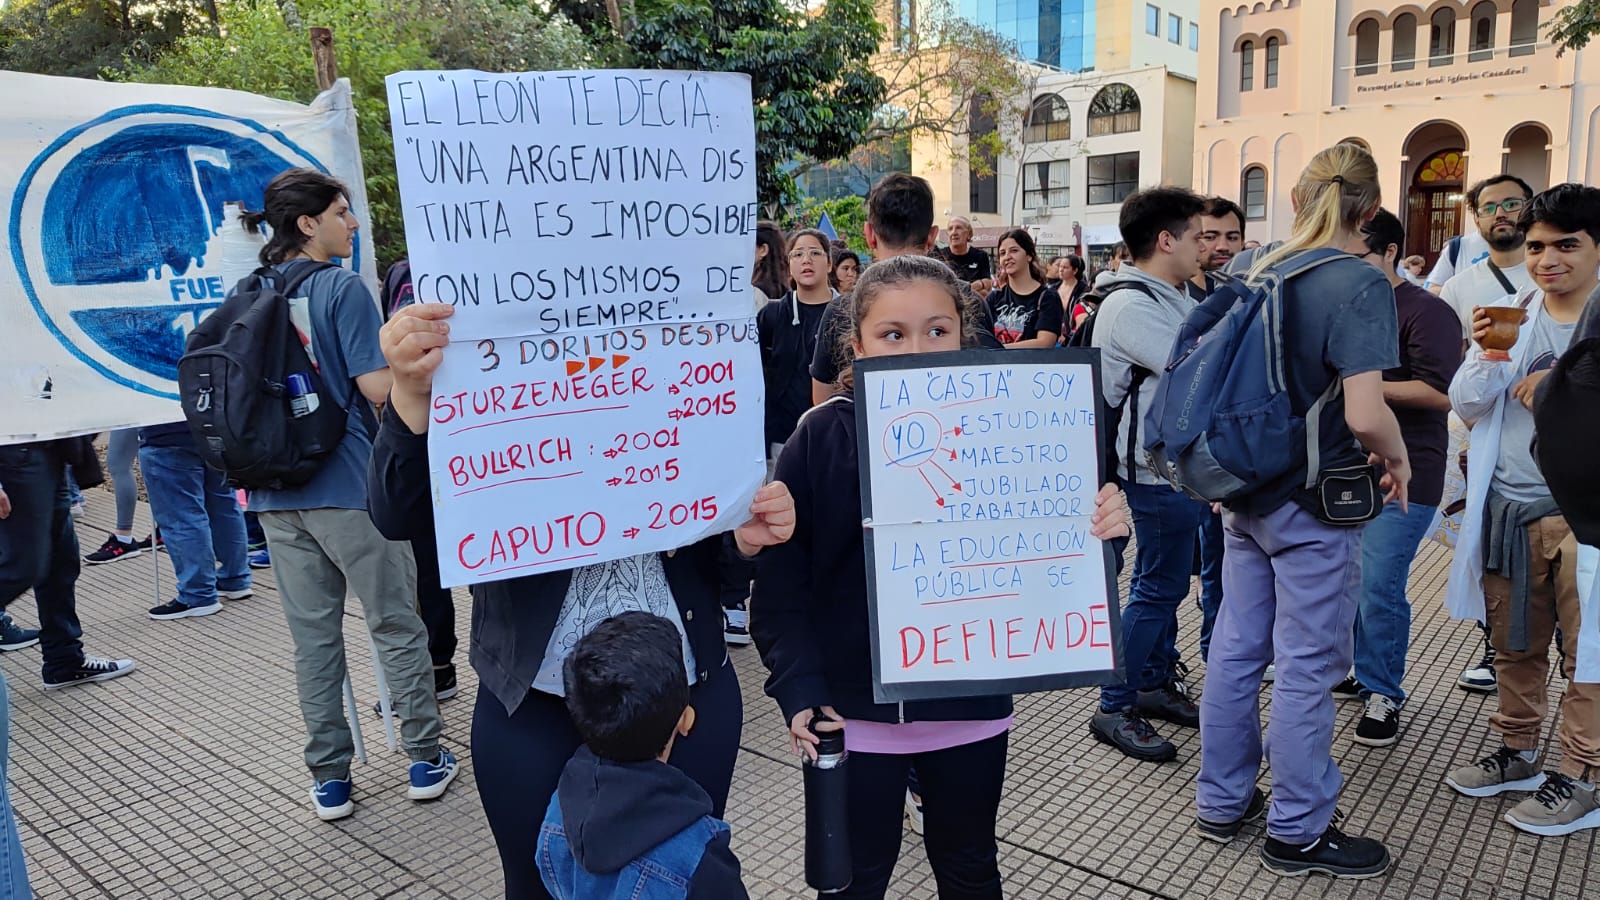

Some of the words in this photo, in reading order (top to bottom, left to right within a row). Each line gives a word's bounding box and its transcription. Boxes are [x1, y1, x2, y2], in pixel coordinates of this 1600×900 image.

[399, 81, 441, 125] EL
[556, 76, 603, 126] TE
[507, 144, 688, 185] ARGENTINA
[416, 200, 511, 243] TINTA
[534, 201, 574, 238] ES
[591, 200, 757, 240] IMPOSIBLE
[417, 272, 480, 306] CON
[493, 268, 556, 304] LOS
[563, 265, 681, 298] MISMOS
[705, 265, 745, 293] DE
[477, 338, 500, 372] 3
[520, 328, 647, 364] DORITOS
[433, 366, 655, 424] STURZENEGER
[680, 360, 734, 388] 2001
[682, 390, 737, 419] 2015
[879, 378, 911, 410] LA
[1032, 371, 1075, 401] SOY
[1181, 359, 1208, 418] CONCEPT
[891, 421, 925, 455] YO
[961, 408, 1095, 436] ESTUDIANTE
[448, 436, 573, 487] BULLRICH
[613, 426, 680, 454] 2001
[624, 457, 680, 486] 2015
[961, 444, 1068, 468] MAESTRO
[964, 473, 1082, 498] JUBILADO
[943, 497, 1082, 521] TRABAJADOR
[457, 511, 606, 570] CAPUTO
[647, 496, 718, 530] 2015
[891, 542, 925, 571] LA
[940, 524, 1086, 564] EDUCACIÓN
[915, 565, 1023, 599] PÚBLICA
[1047, 566, 1075, 588] SE
[898, 604, 1110, 669] DEFIENDE
